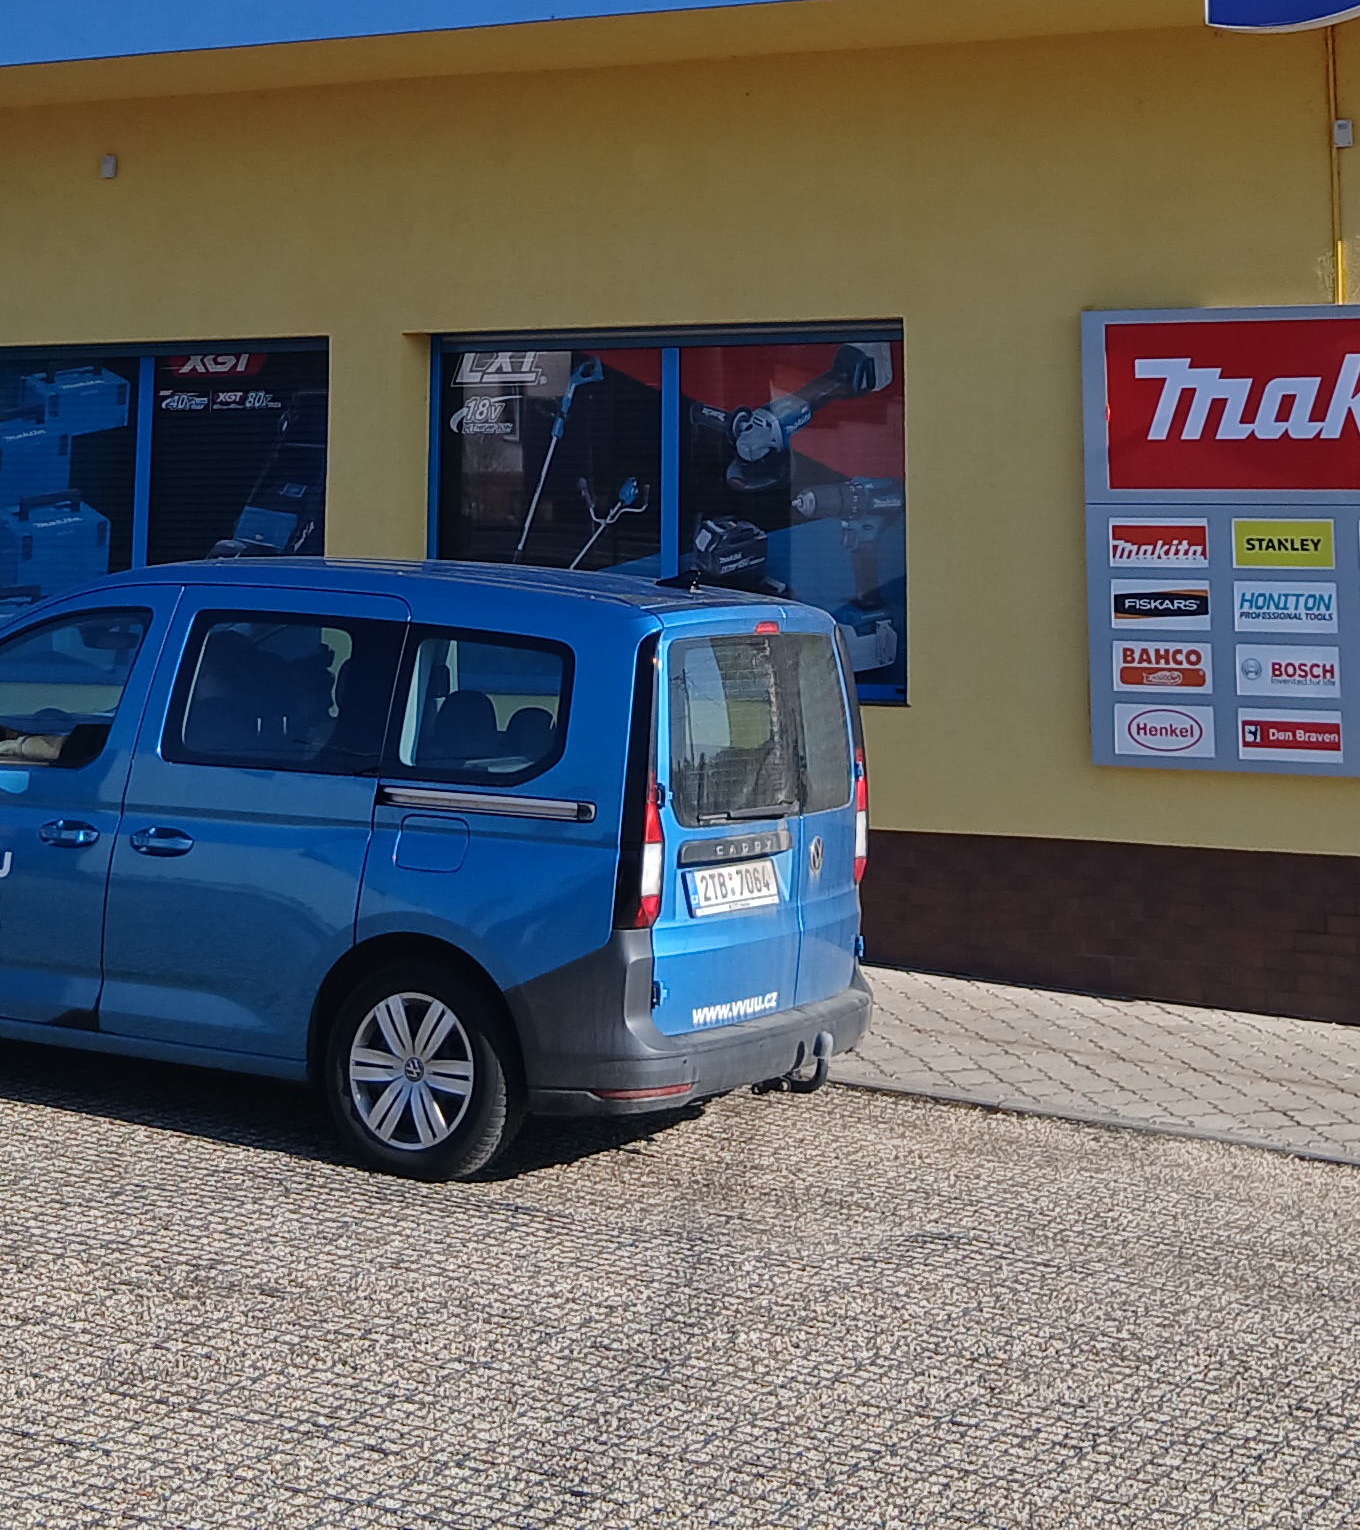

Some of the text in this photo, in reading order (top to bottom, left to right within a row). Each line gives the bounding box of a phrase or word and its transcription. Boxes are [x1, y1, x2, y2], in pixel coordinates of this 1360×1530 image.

[1246, 538, 1322, 552] STANLEY
[1125, 599, 1198, 610] FISKARS
[1240, 592, 1332, 611] HONITON
[1240, 612, 1333, 621] PROFESSIONAL TOOLS
[1122, 648, 1202, 666] BAHCO
[1271, 662, 1335, 678] BOSCH
[1136, 722, 1195, 738] Henkel
[1296, 730, 1339, 743] Braven
[716, 840, 773, 856] CADDY
[700, 865, 771, 902] 2TB 7064
[692, 991, 778, 1025] www.vvuu.cz
